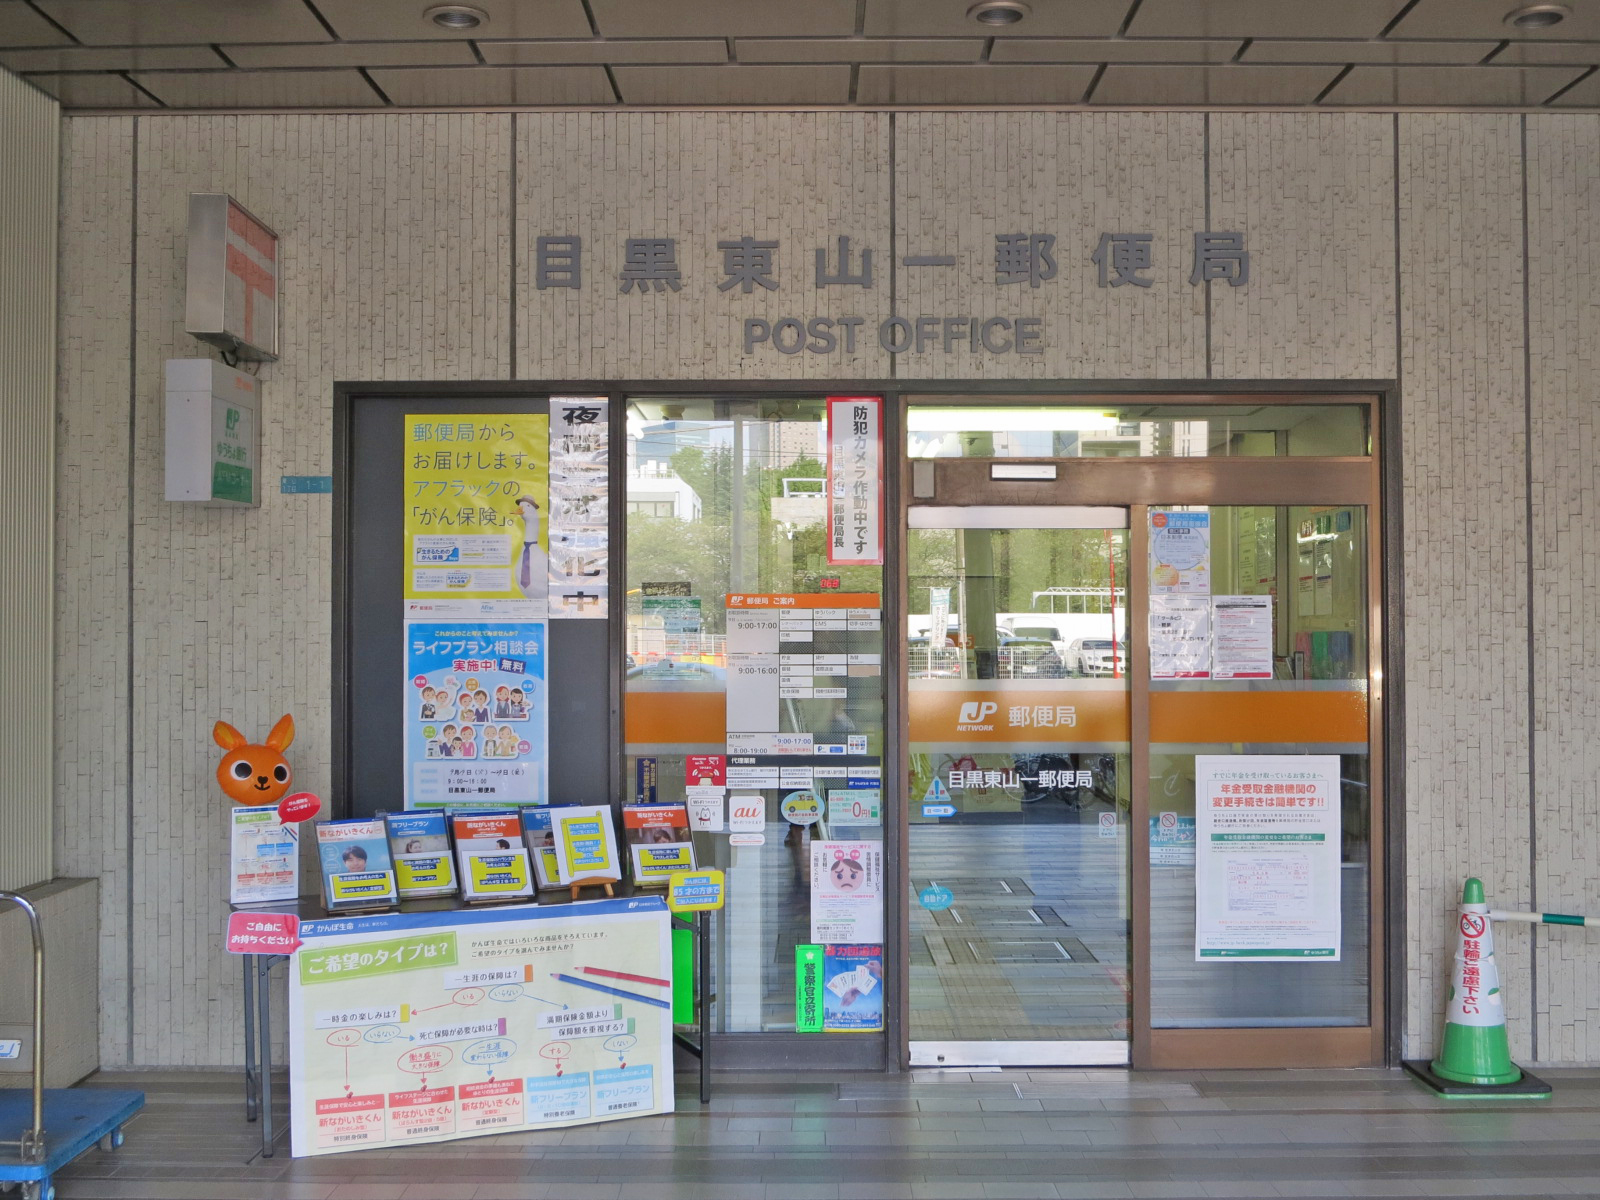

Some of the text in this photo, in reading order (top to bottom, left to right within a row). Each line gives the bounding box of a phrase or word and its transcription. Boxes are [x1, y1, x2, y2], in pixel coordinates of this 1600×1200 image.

[535, 232, 1249, 293] 目黒東山一郵便局
[744, 315, 1042, 355] POST OFFICE
[413, 423, 515, 442] 郵便局から
[413, 451, 536, 470] お届けします。
[853, 405, 868, 555] 防犯カメラ作動中です
[413, 480, 520, 497] アフラックの
[413, 506, 514, 527] 「がん保険」。
[746, 597, 769, 605] 郵便局
[772, 597, 795, 605] ご案内
[738, 622, 778, 630] 9:00-17:00
[413, 640, 539, 656] ライフプラン相談会
[453, 658, 524, 673] 実施中! 無料
[738, 667, 778, 675] 9:00-16:00
[1008, 706, 1077, 728] 郵便局
[956, 724, 994, 732] NETWORK
[948, 770, 1093, 789] 目黒東山一郵便局
[1212, 772, 1324, 780] すでに年金を受け取っているお客さまへ
[1220, 784, 1316, 794] 年金受取金融機関の
[1212, 796, 1324, 808] 変更手続きは簡単です!!
[734, 806, 762, 818] au
[391, 820, 429, 828] 新フリープラン
[319, 828, 373, 837] 新ながいきくん
[673, 886, 720, 896] 85 才の方まで
[924, 894, 948, 903] 自動ドア
[246, 922, 282, 932] ご自由に
[316, 922, 354, 932] かんぽ生命
[231, 935, 294, 945] お持ちください
[472, 932, 608, 948] かんぽ生命ではいろいろな商品をそろえています。
[472, 944, 574, 958] ご希望のタイプを選んでみませんか？
[308, 942, 448, 975] ご希望のタイプは？
[455, 970, 518, 982] 一生涯の保障は？
[804, 962, 816, 1027] 警察官立寄所
[323, 1010, 397, 1023] 一時金の楽しみは？
[546, 1010, 608, 1024] 満期保険金額より
[419, 1024, 498, 1041] 死亡保障が必要な時は？
[558, 1023, 624, 1036] 保障額を重視する？
[338, 1030, 395, 1042] いる いらない
[478, 1042, 500, 1051] 一生涯
[612, 1040, 628, 1048] しない
[408, 1051, 442, 1062] 働き盛りに
[470, 1050, 509, 1061] 変わらない保障
[412, 1060, 440, 1070] 大きな保障
[530, 1090, 588, 1104] 新フリープラン
[596, 1086, 650, 1099] 新フリープラン
[462, 1098, 520, 1111] 新ながいきくん
[608, 1102, 638, 1110] 普通養老保険
[392, 1108, 452, 1120] 新ながいきくん
[543, 1110, 576, 1118] 特別養老保険
[319, 1114, 382, 1127] 新ながいきくん
[476, 1116, 508, 1126] 普通終身保険
[406, 1126, 440, 1134] 普通終身保険
[334, 1134, 368, 1142] 特別終身保険
